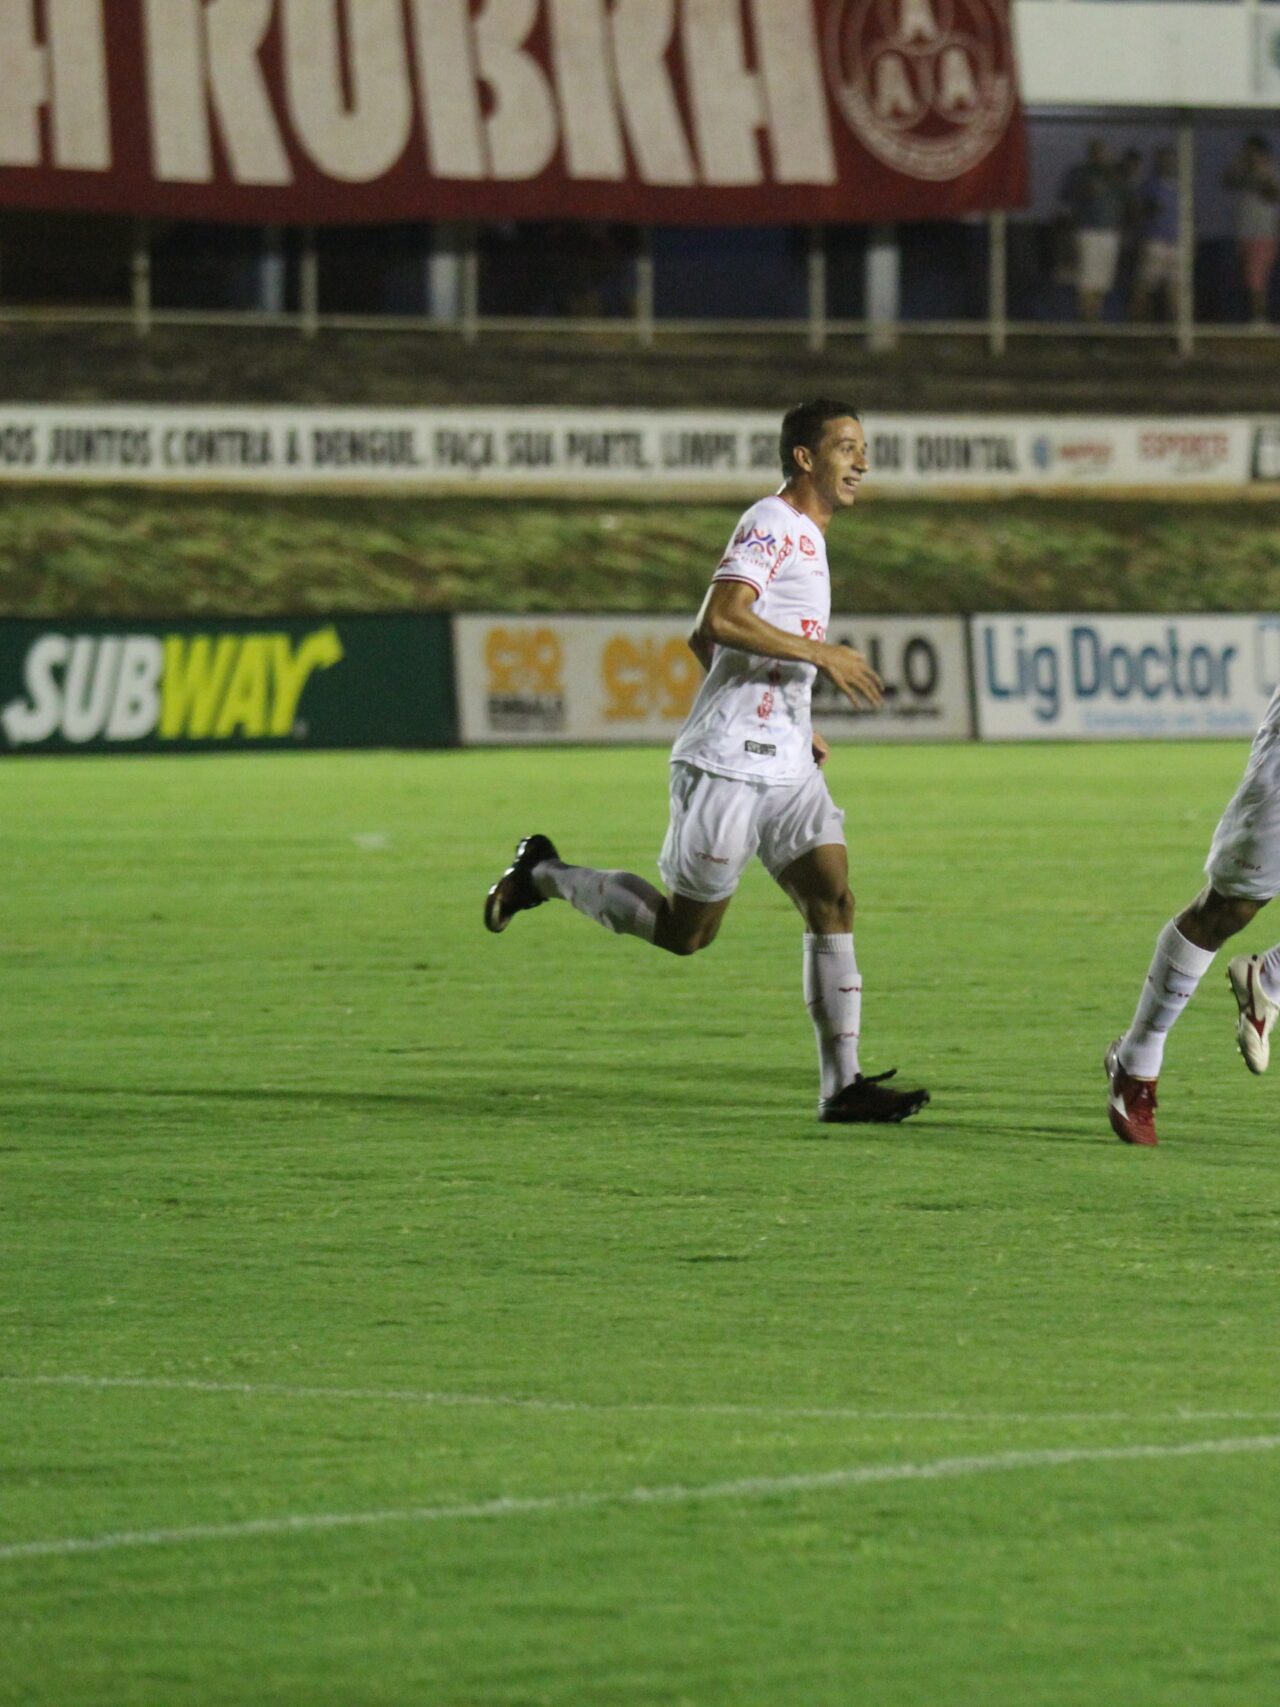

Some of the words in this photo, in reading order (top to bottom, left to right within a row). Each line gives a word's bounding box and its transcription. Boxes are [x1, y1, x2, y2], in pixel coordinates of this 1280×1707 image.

[143, 0, 838, 187] RUBRA
[46, 427, 153, 466] JUNTOS
[163, 428, 273, 467] CONTRA
[287, 429, 301, 467] A
[433, 430, 494, 480] FAÇA
[506, 430, 552, 468] SUA
[916, 435, 1017, 473] QUINTAL
[2, 625, 343, 743] SUBWAY
